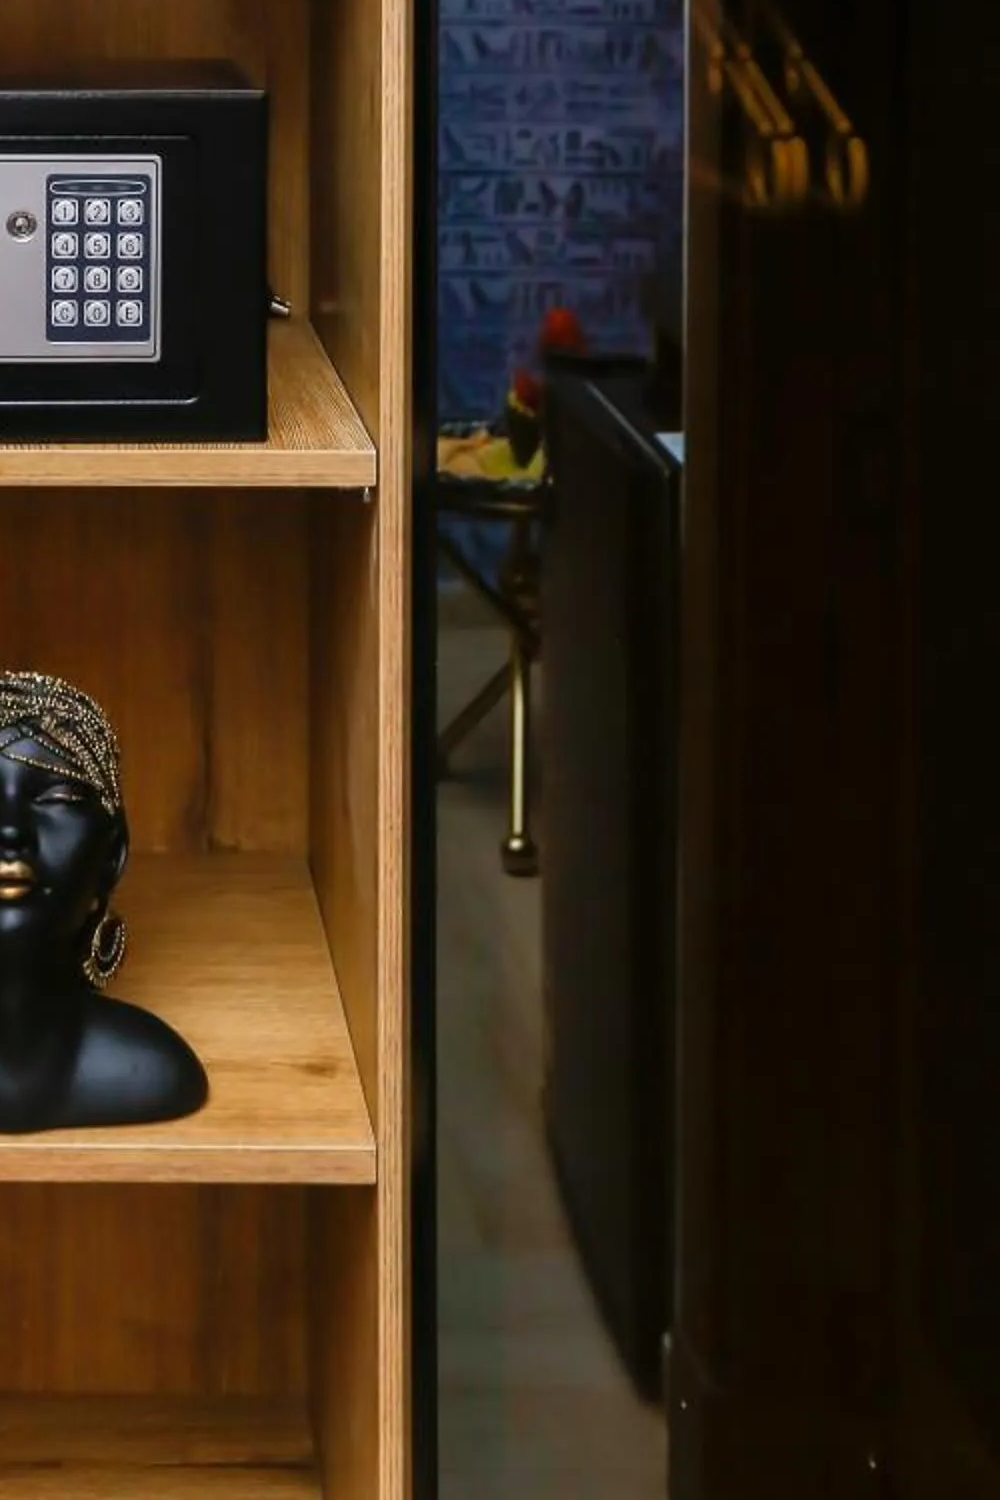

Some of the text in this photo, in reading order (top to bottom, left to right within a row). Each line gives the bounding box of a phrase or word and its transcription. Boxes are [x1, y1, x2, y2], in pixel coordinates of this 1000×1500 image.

[93, 205, 101, 219] 2
[126, 206, 135, 219] 3
[60, 240, 135, 253] 4 5 6
[61, 273, 134, 286] 7 8 9
[60, 307, 69, 320] C
[125, 308, 133, 320] E
